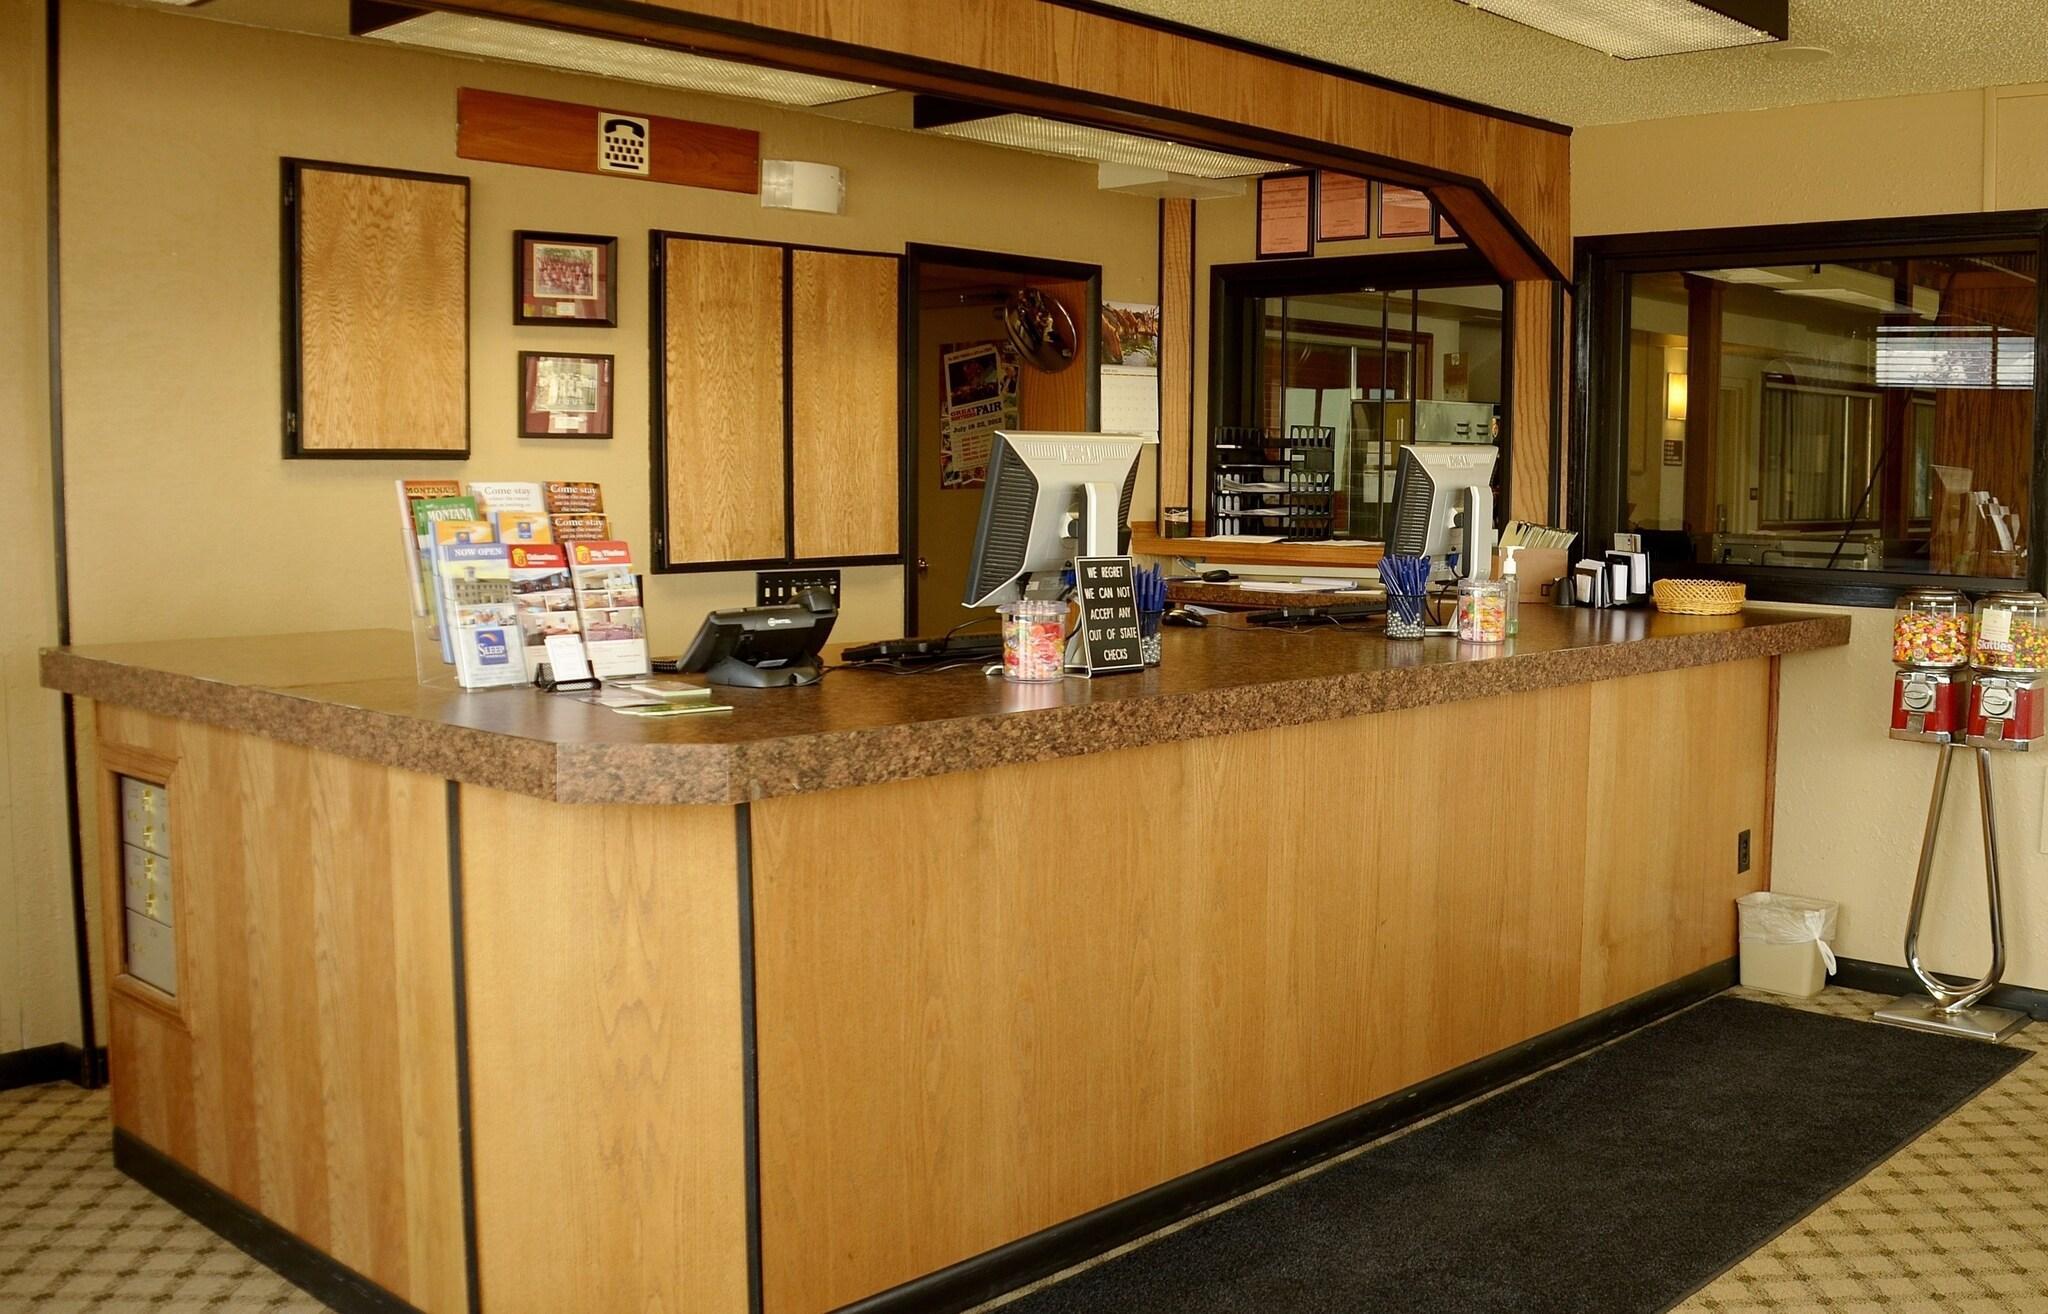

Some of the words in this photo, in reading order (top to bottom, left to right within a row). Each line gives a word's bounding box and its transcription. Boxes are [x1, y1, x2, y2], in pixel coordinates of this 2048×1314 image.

[976, 401, 1002, 416] FAIR
[953, 424, 967, 433] July
[484, 486, 512, 495] Come
[514, 487, 531, 496] stay
[550, 484, 577, 493] Come
[580, 486, 597, 496] stay
[427, 507, 473, 521] MONTANA
[555, 518, 583, 527] Come
[585, 519, 603, 529] stay
[454, 548, 476, 557] NOW
[478, 547, 503, 556] OPEN
[1087, 567, 1098, 578] WE
[1101, 566, 1123, 578] REGRET
[1084, 588, 1095, 599] WE
[1099, 587, 1113, 599] CAN
[1116, 586, 1131, 598] NOT
[1090, 607, 1114, 620] ACCEPT
[1118, 607, 1131, 618] ANY
[1088, 629, 1102, 641] OUT
[1106, 629, 1115, 640] OF
[1120, 627, 1137, 639] STATE
[479, 644, 505, 657] SLEEP
[1977, 640, 2015, 653] Skittles
[1103, 648, 1128, 661] CHECKS
